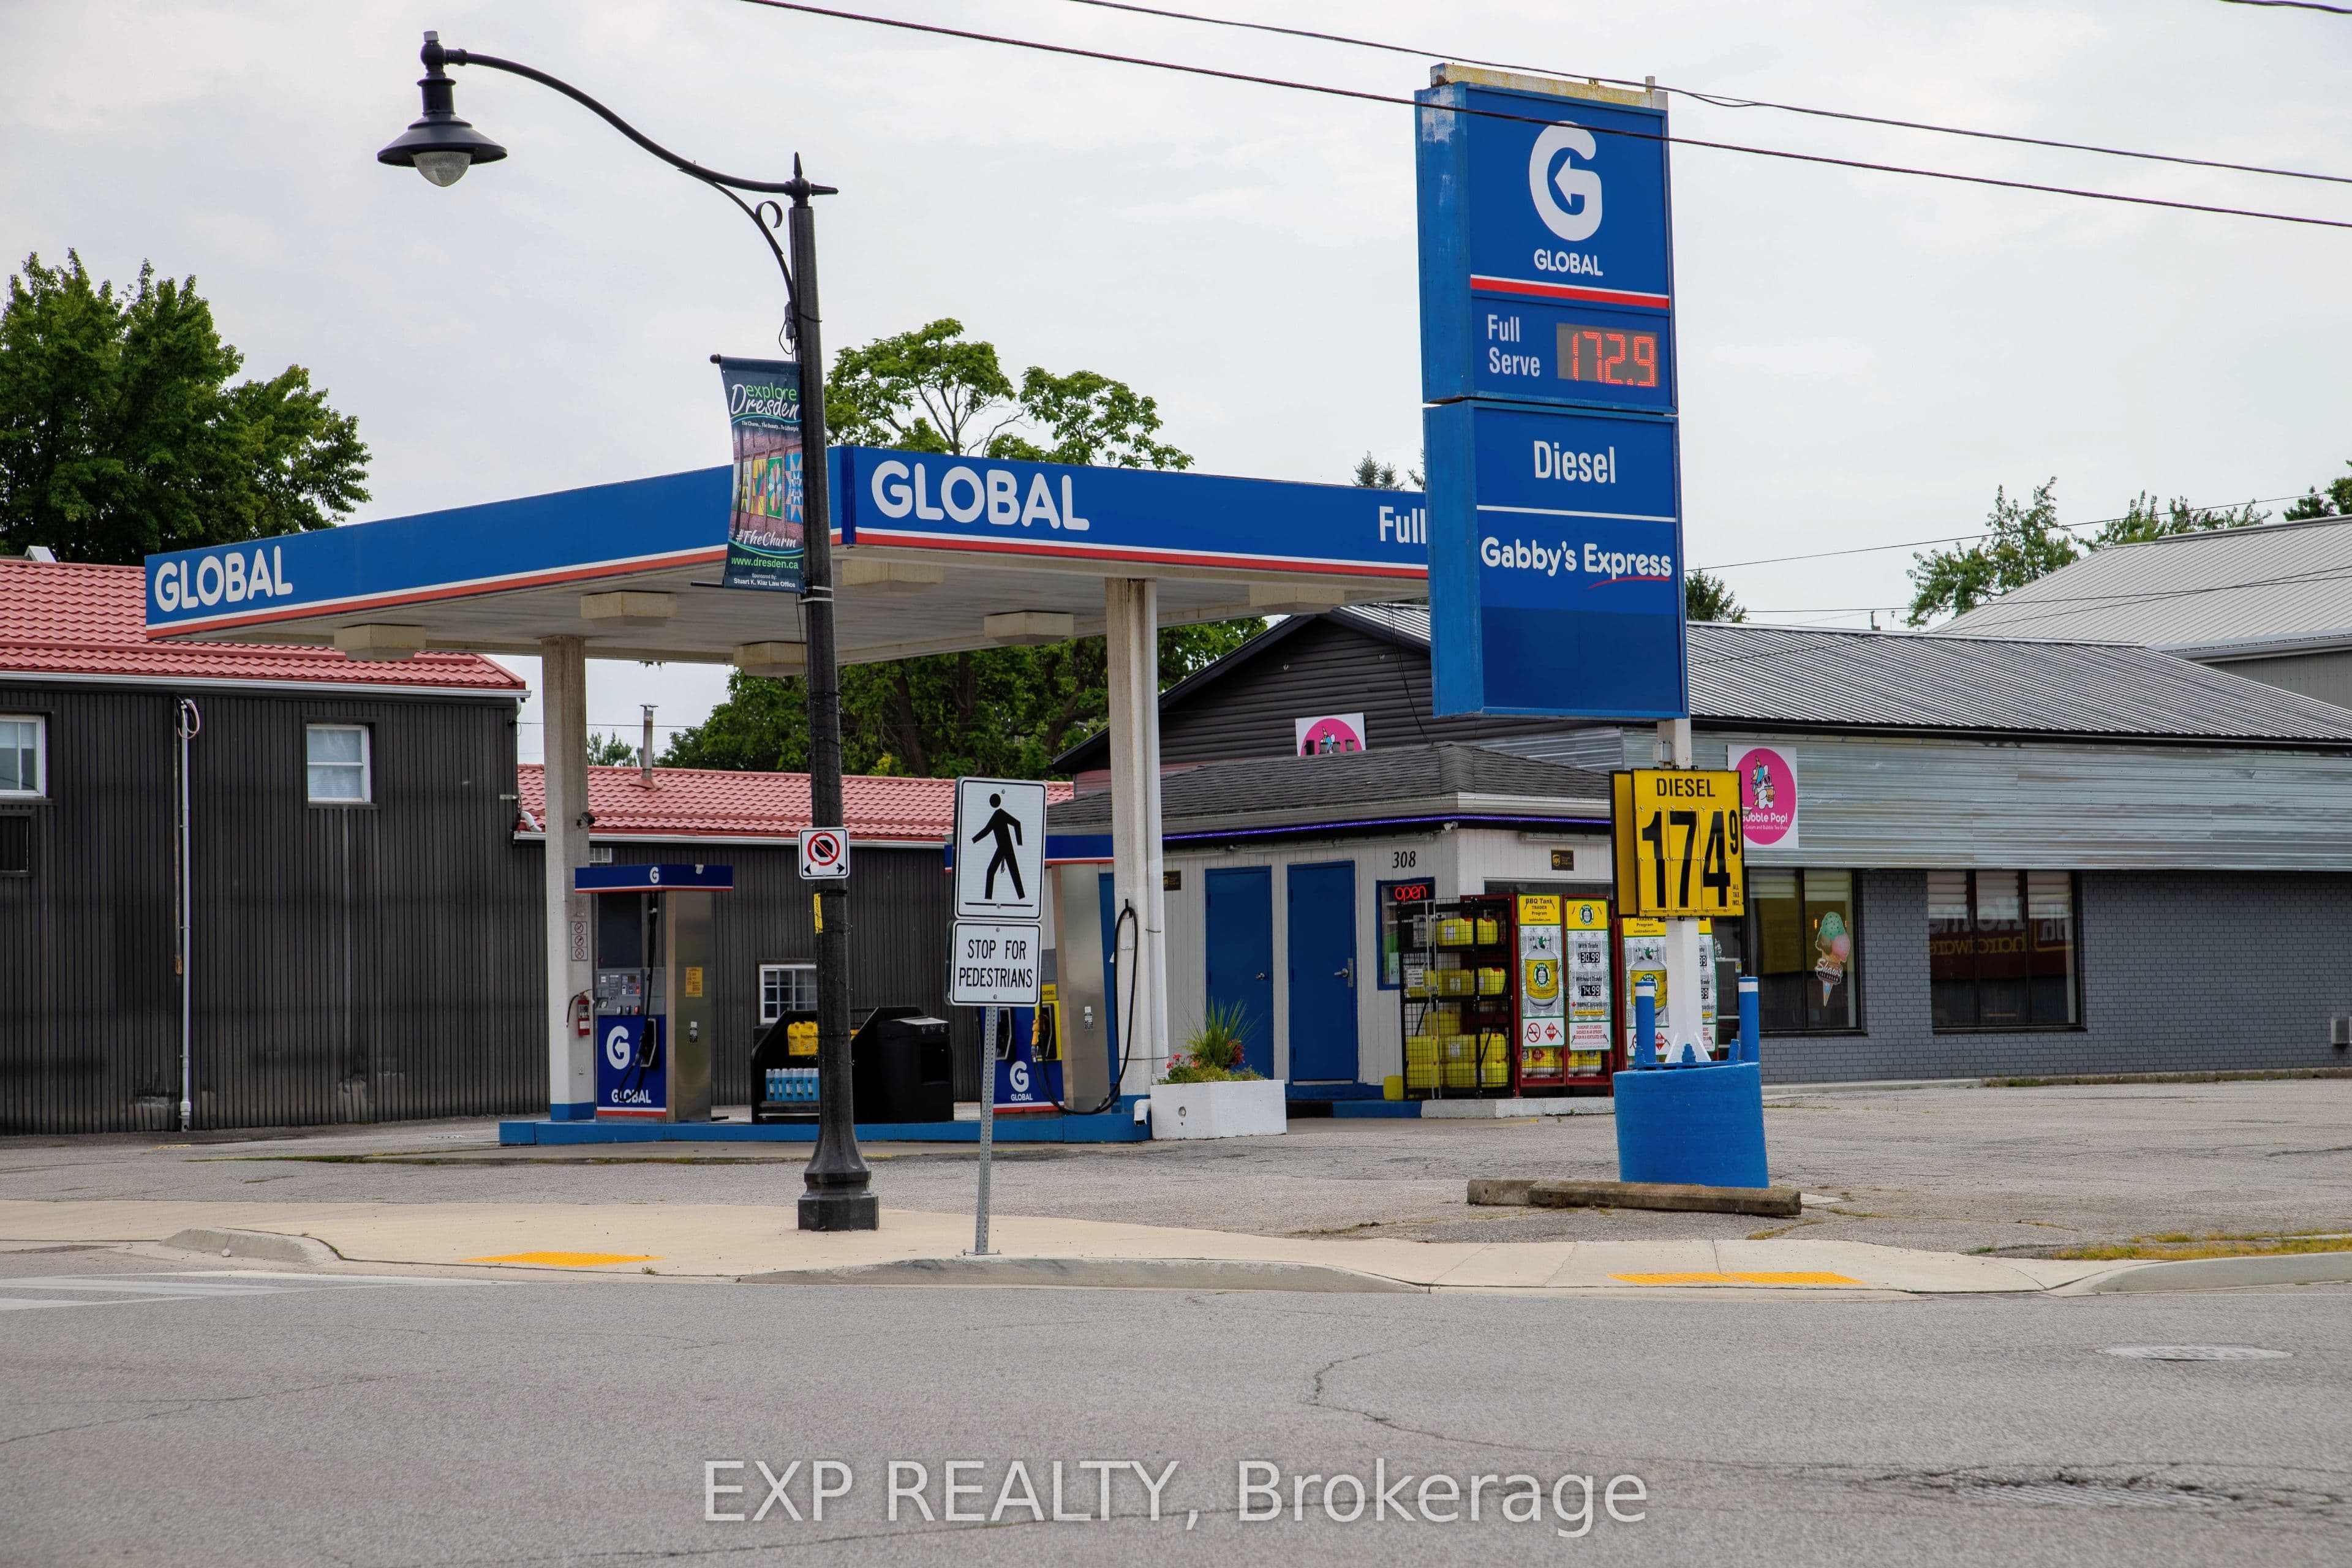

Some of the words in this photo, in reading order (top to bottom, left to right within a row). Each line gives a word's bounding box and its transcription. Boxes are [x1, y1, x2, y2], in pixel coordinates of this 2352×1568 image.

[1534, 249, 1603, 276] GLOBAL
[1488, 314, 1520, 342] Full
[1489, 347, 1540, 377] Serve
[1572, 331, 1656, 387] 172.9
[731, 384, 799, 420] Dresden
[746, 382, 796, 402] explore
[1534, 440, 1616, 484] Diesel
[871, 460, 1090, 531] GLOBAL
[736, 529, 796, 548] #TheCharm
[1379, 505, 1426, 545] Full
[731, 557, 799, 570] www.dresden.ca
[1481, 536, 1577, 577] Gabby's
[1584, 543, 1672, 580] Express
[155, 546, 293, 612] GLOBAL
[1656, 778, 1716, 797] DIESEL
[1771, 812, 1788, 825] Pop!
[1392, 851, 1417, 869] 308
[1395, 885, 1427, 902] open
[967, 939, 996, 959] STOP
[1005, 940, 1026, 960] FOR
[959, 967, 1033, 989] PEDESTRIANS
[606, 1026, 630, 1069] G
[1009, 1061, 1029, 1092] G
